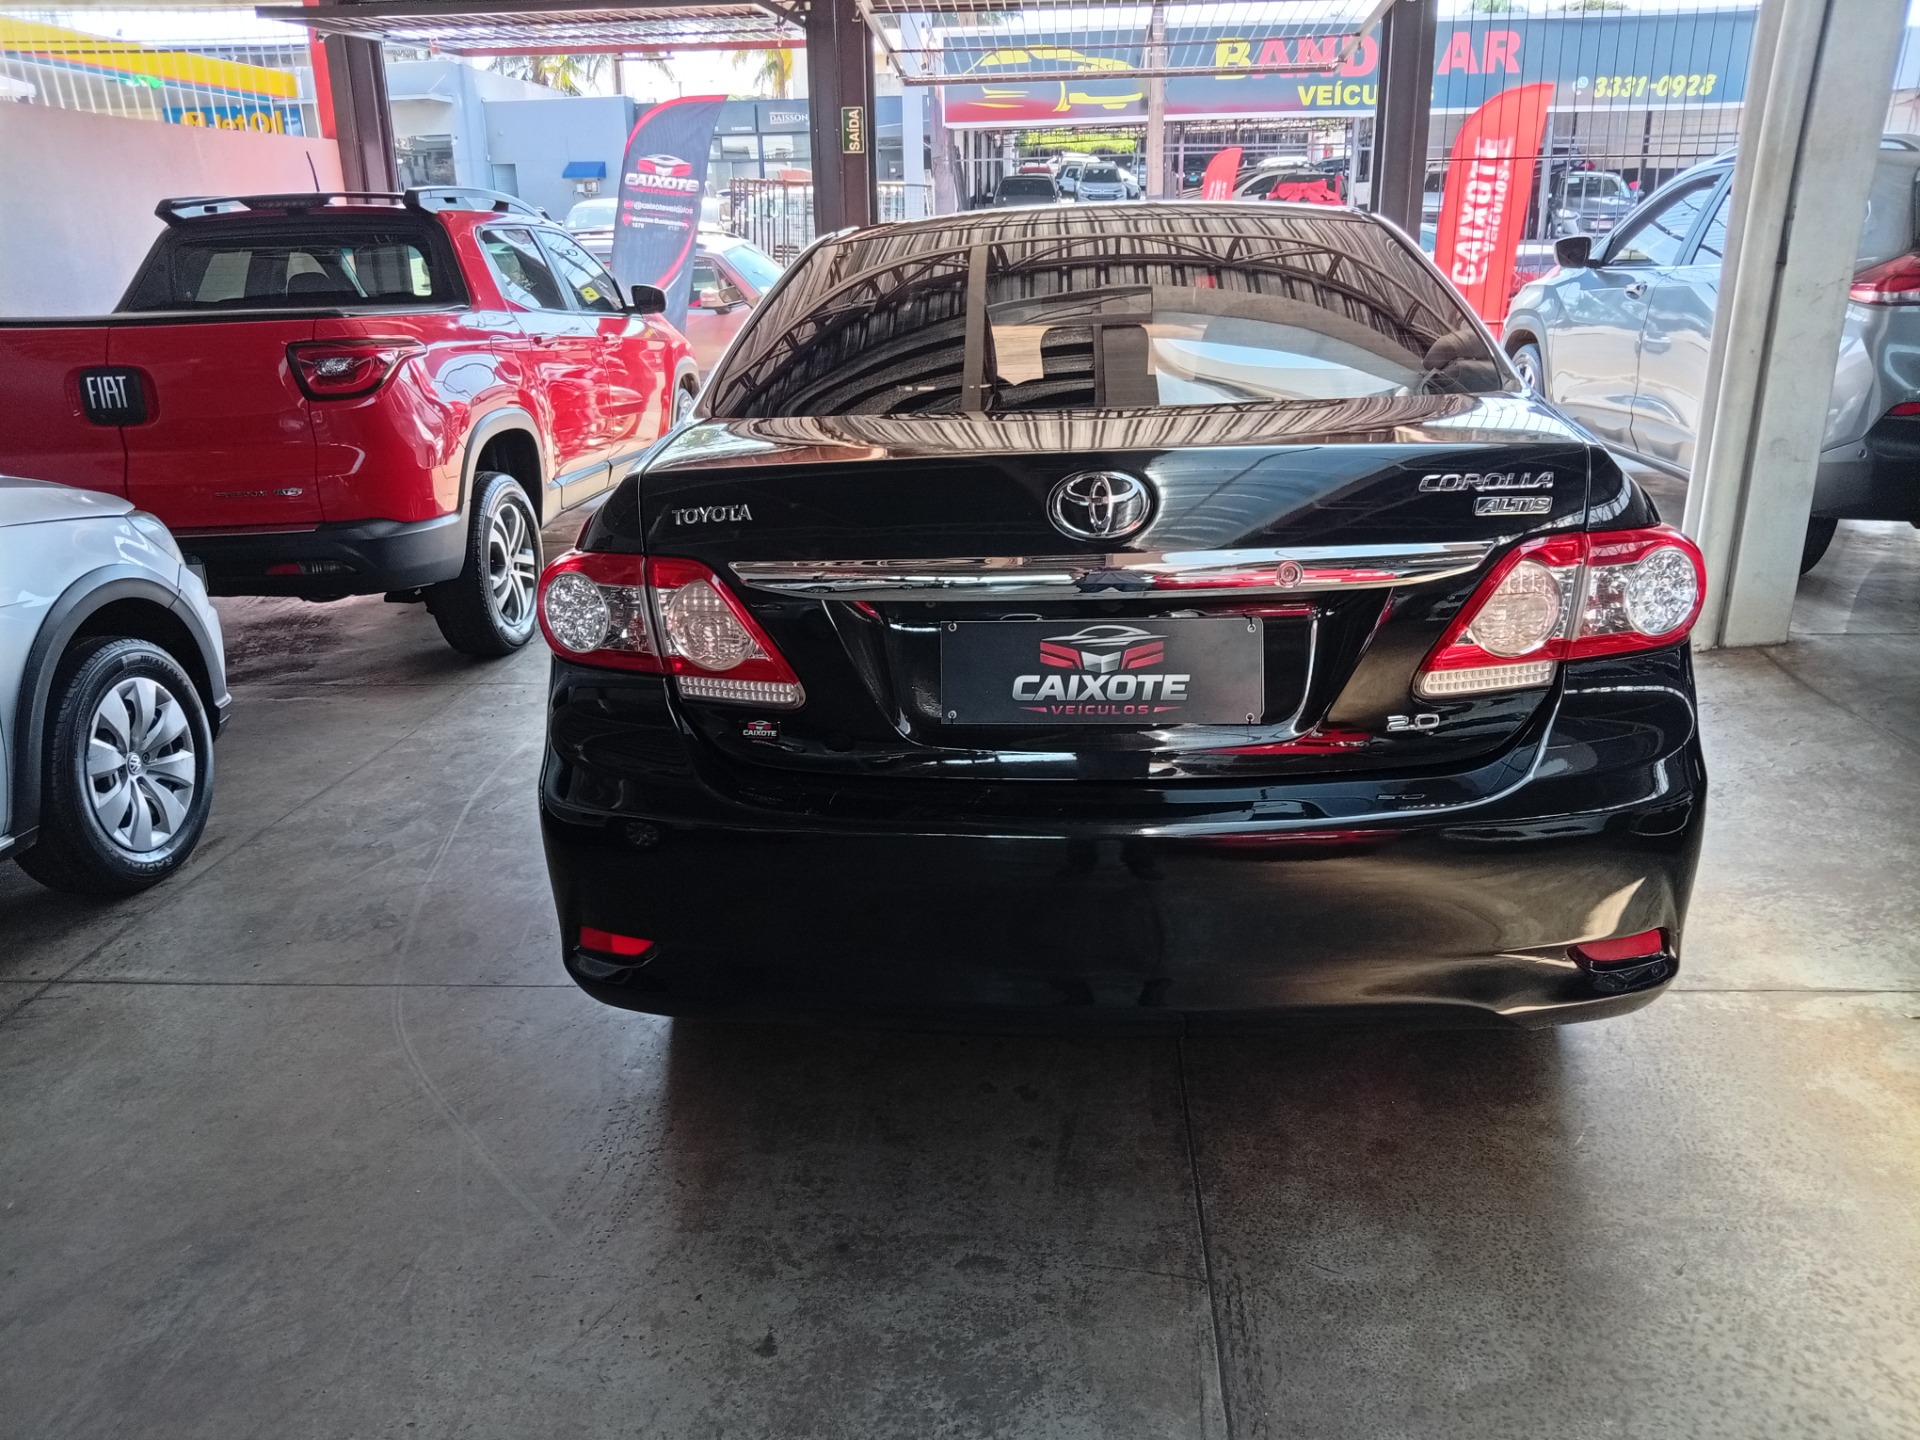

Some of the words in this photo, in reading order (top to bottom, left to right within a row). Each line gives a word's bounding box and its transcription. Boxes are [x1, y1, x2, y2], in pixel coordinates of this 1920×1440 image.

[1215, 30, 1521, 80] BANDAR
[1593, 74, 1717, 98] 3331-0928
[846, 109, 860, 151] SAÍDA
[625, 172, 699, 192] CAIXOTE
[1452, 136, 1501, 285] CAIXOTE
[86, 375, 128, 409] FIAT
[1418, 471, 1555, 492] COROLLA
[671, 504, 753, 525] TOYOTA
[1476, 496, 1551, 514] ALTIS
[1012, 674, 1191, 701] CAIXOTE
[1051, 703, 1149, 715] VEÍCULOS
[742, 729, 777, 737] CAIXOTE
[1386, 713, 1440, 732] 2.0
